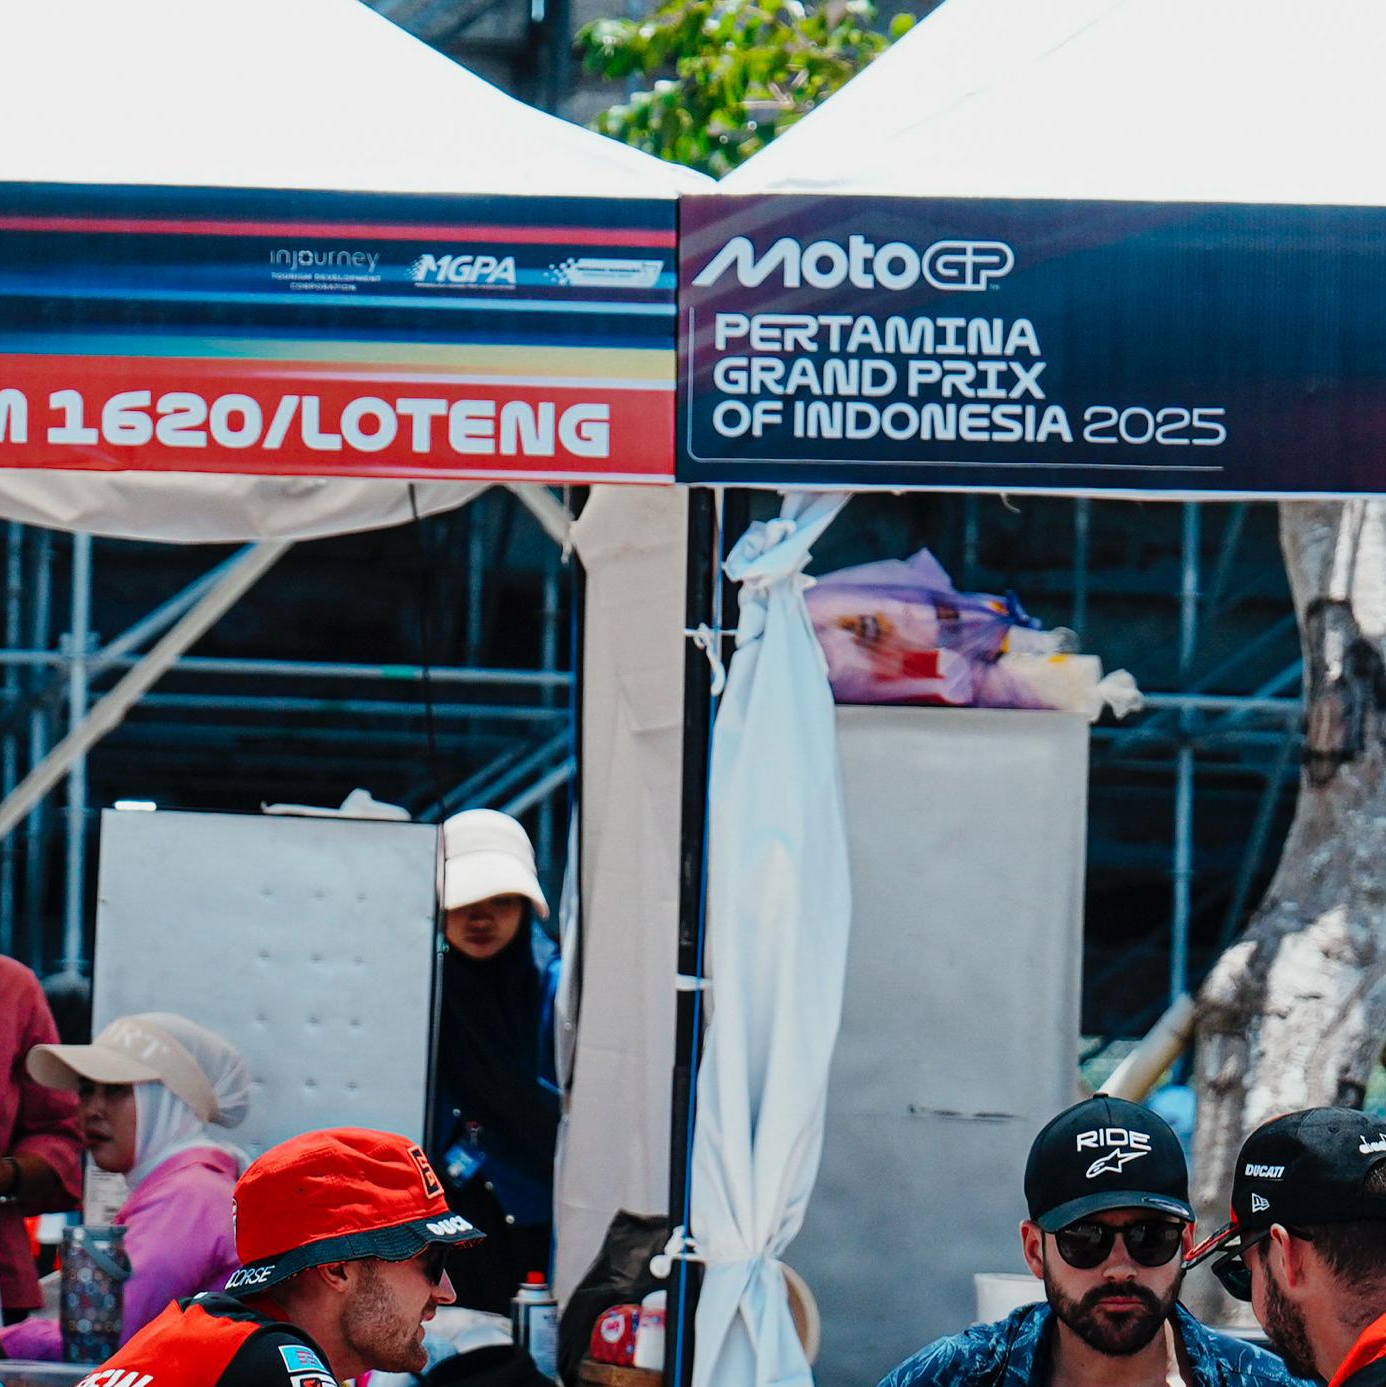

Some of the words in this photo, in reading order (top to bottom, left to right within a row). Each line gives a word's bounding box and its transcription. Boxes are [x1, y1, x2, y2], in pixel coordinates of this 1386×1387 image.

[270, 249, 381, 273] injourney
[411, 253, 517, 283] MGPA
[692, 234, 1014, 291] MotoGP
[715, 312, 1042, 357] PERTAMINA
[713, 357, 897, 398] GRAND
[907, 361, 1047, 400] PRIX
[47, 389, 611, 458] 1620/LOTENG
[712, 401, 783, 438] OF
[794, 401, 1073, 444] INDONESIA
[1083, 406, 1228, 447] 2025
[1076, 1128, 1152, 1152] RIDE
[1244, 1163, 1285, 1178] DUCATI
[224, 1265, 275, 1290] CORSE
